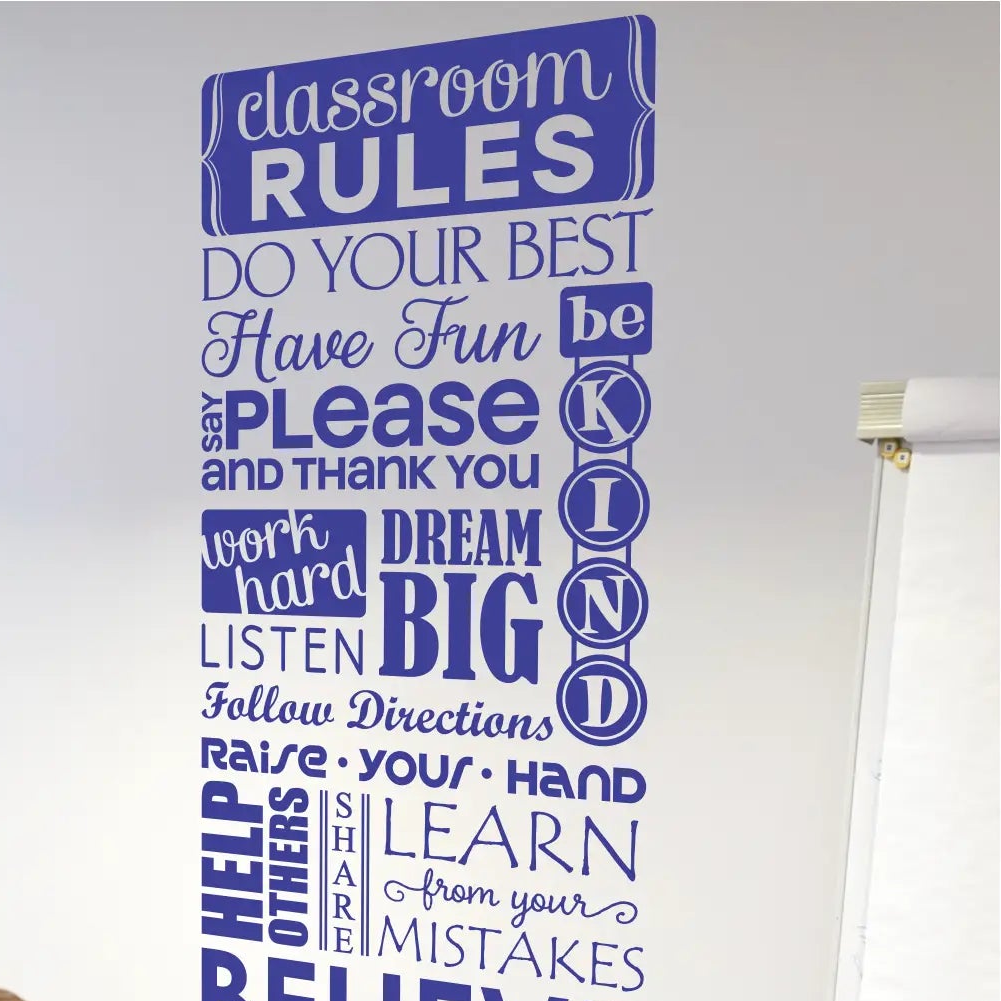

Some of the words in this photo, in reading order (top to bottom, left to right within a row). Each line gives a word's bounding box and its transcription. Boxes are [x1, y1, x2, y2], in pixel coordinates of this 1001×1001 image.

[238, 48, 611, 141] classroom
[251, 114, 594, 221] RULES
[203, 242, 295, 301] DO
[312, 226, 489, 293] YOUR
[509, 209, 651, 280] BEST
[201, 309, 373, 382] Have
[395, 296, 540, 369] Fun
[567, 295, 645, 343] be
[447, 454, 539, 488] YOU
[201, 509, 329, 569] work
[381, 508, 543, 567] DREAM
[235, 545, 366, 614] hard
[201, 625, 363, 674] LISTEN
[378, 571, 544, 685] BIG
[202, 682, 334, 727] Follow
[347, 691, 553, 740] Directions
[202, 781, 263, 941] HELP
[269, 788, 308, 946] OTHERS
[332, 792, 357, 954] SHARE
[384, 797, 639, 882] LEARN
[384, 868, 500, 910] from
[511, 889, 638, 928] your
[377, 915, 645, 992] MISTAKES
